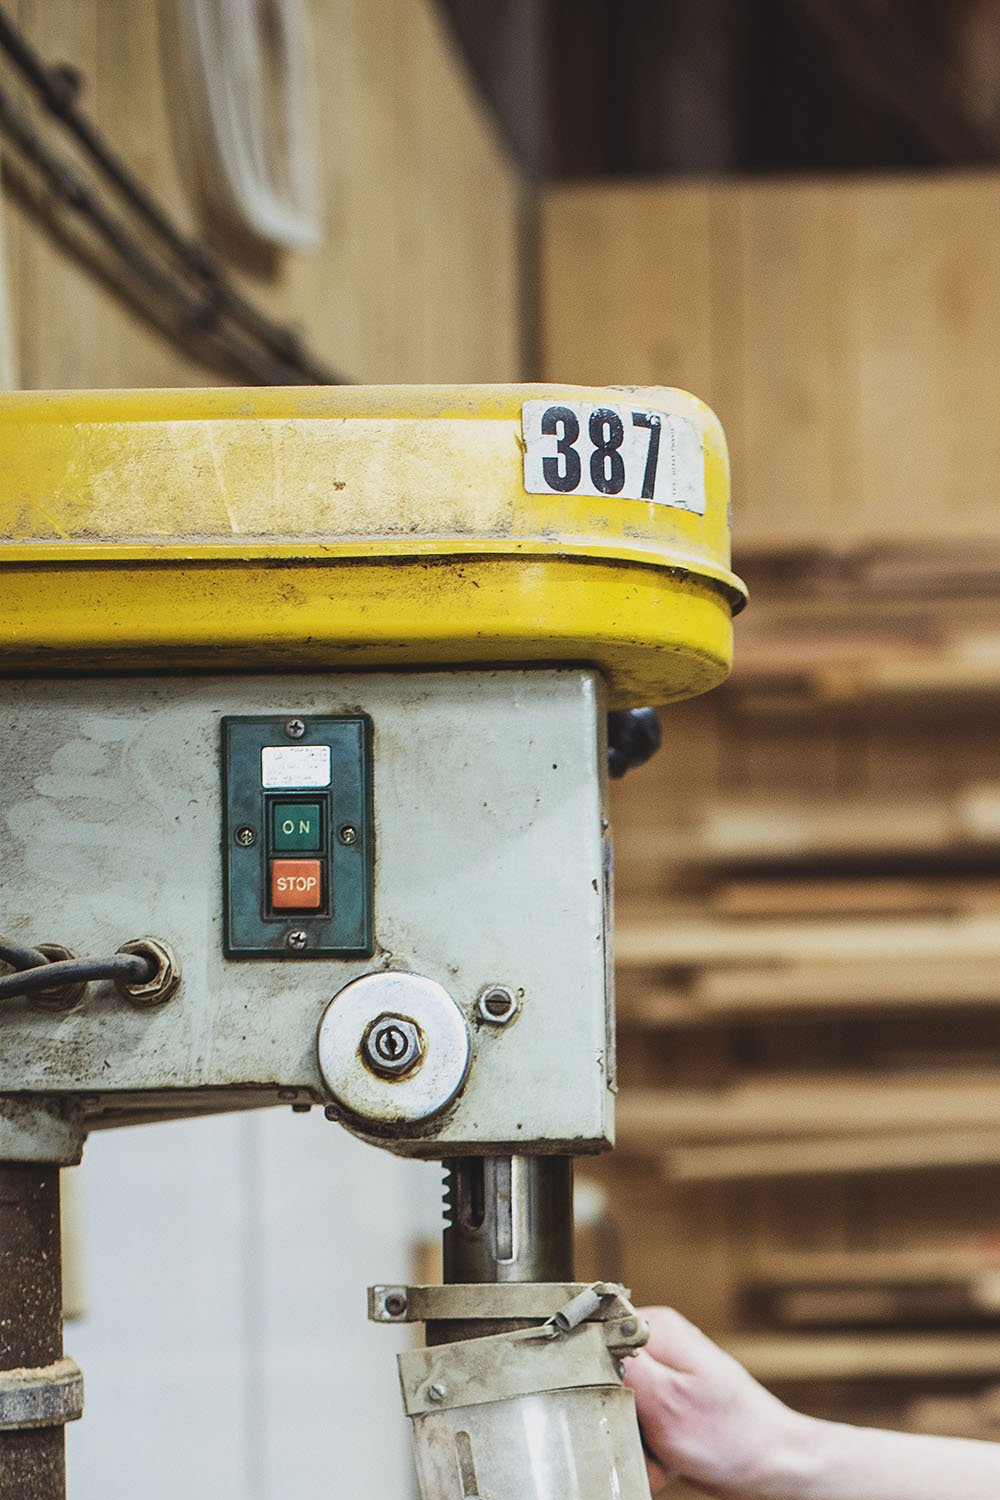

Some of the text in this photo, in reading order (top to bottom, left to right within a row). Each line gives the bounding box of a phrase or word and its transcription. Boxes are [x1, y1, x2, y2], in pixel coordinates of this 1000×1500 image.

[541, 406, 661, 500] 387
[282, 820, 310, 835] ON
[276, 876, 316, 892] STOP
